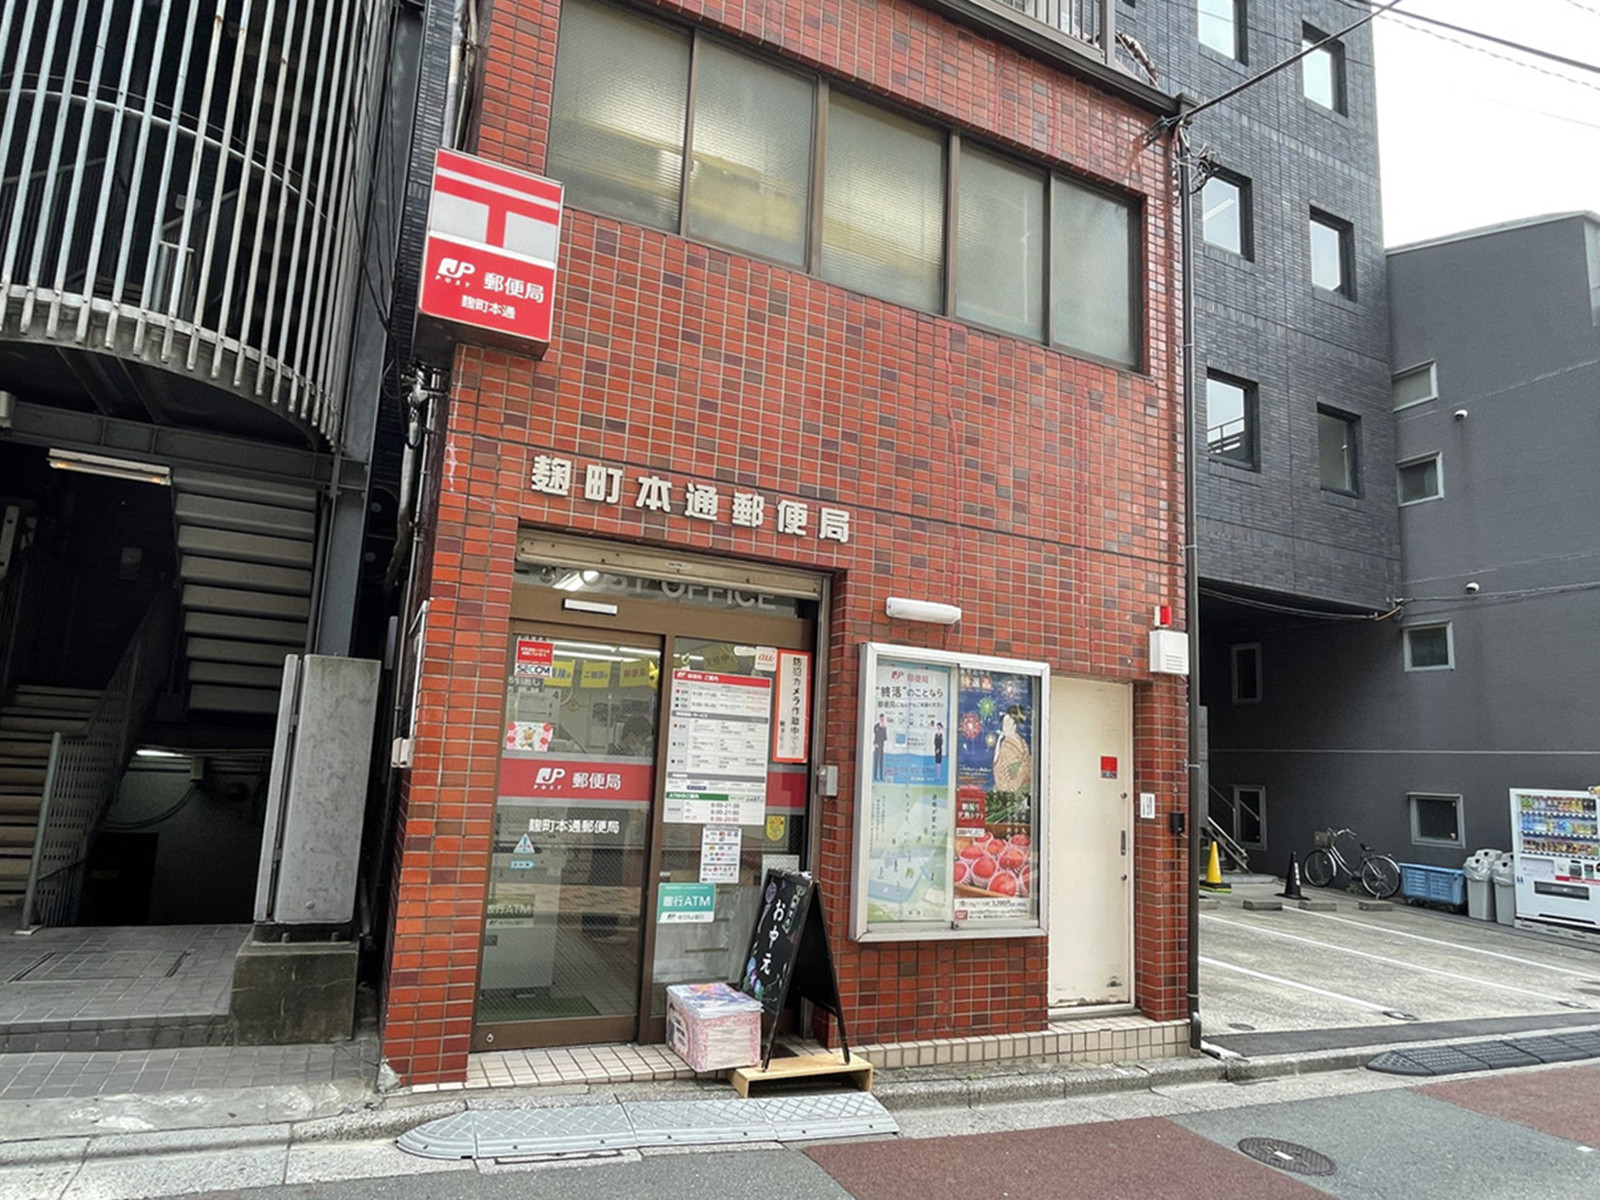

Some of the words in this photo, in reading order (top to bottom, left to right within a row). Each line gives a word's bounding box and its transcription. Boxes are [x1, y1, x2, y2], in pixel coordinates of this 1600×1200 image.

[483, 272, 544, 303] 郵便局
[572, 772, 621, 790] 郵便局
[663, 895, 711, 907] 銀行ATM
